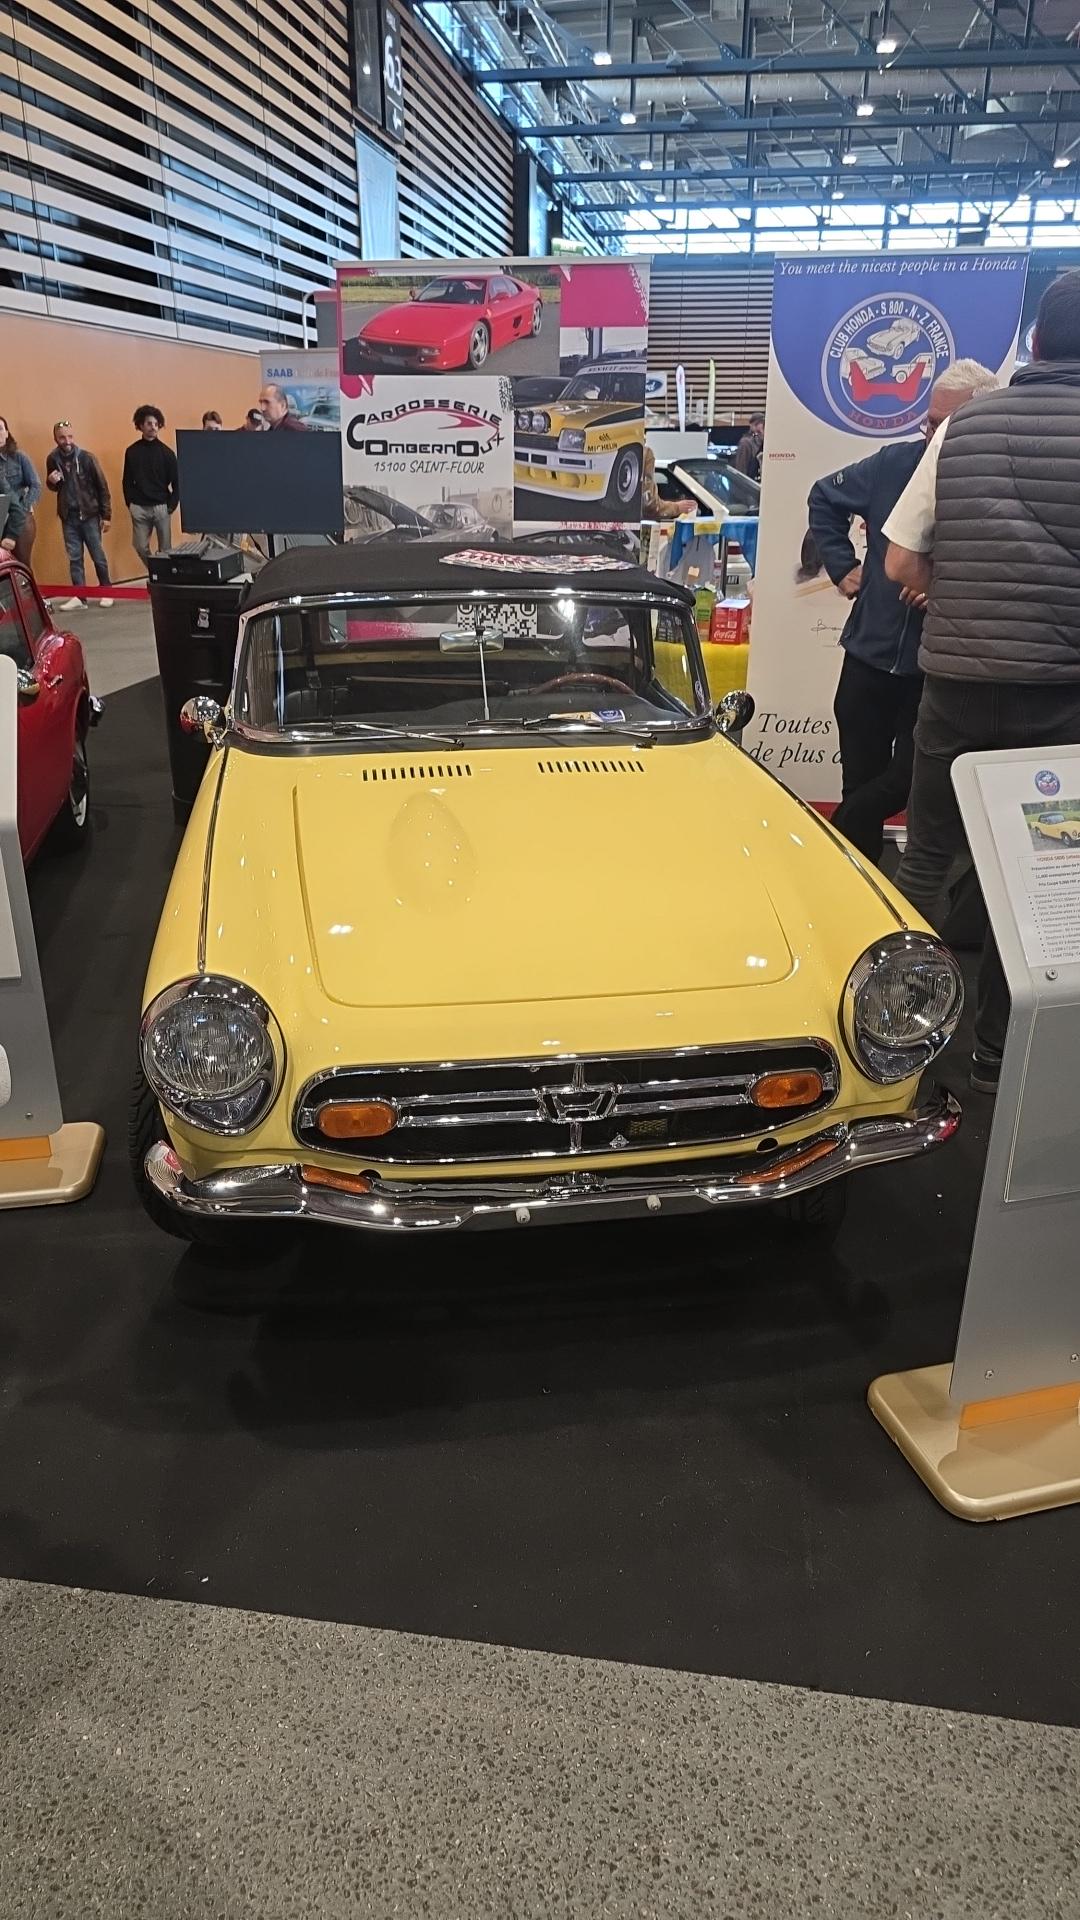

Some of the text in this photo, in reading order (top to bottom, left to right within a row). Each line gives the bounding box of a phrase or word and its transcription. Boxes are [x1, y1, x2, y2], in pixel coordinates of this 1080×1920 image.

[779, 261, 801, 275] You
[806, 260, 835, 274] meet
[838, 259, 858, 273] the
[861, 259, 897, 273] nicest
[898, 259, 939, 276] people
[943, 258, 956, 272] in
[959, 261, 968, 271] a
[971, 257, 1017, 271] Honda
[830, 300, 949, 359] CLUB HONDA S 800 N Z FRANCE
[266, 368, 293, 378] SAAB
[847, 409, 919, 429] HONDA
[587, 443, 618, 452] MICHELIN
[374, 459, 485, 474] 15100 SAINT-FLOUR
[758, 712, 832, 735] Toutes
[749, 741, 774, 762] de
[777, 742, 825, 768] plus
